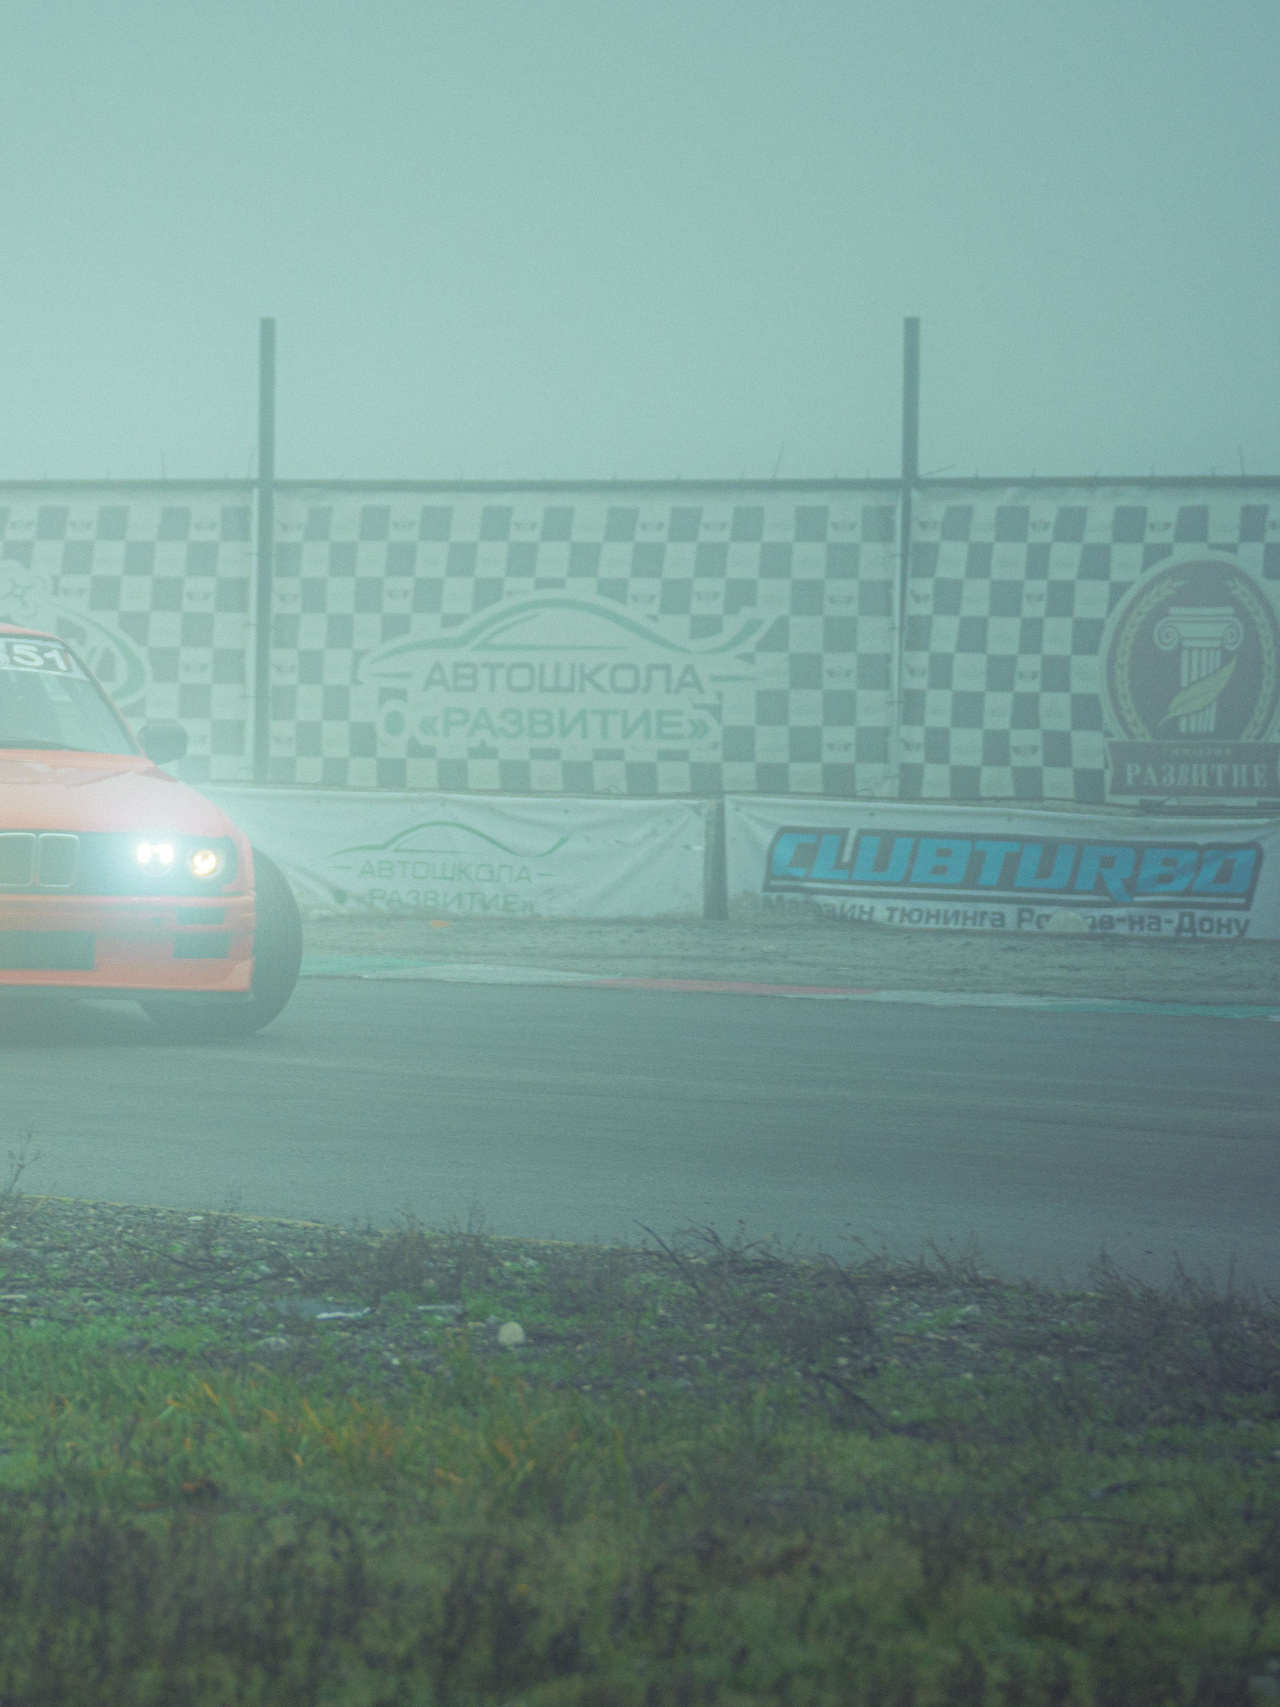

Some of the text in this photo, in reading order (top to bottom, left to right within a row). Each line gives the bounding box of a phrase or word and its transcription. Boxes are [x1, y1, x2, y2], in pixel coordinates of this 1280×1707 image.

[13, 643, 68, 672] 51
[422, 661, 704, 694] АВТОШКОЛА
[418, 706, 712, 741] «РАЗВИТИЕ»
[1125, 762, 1269, 788] РАЗВИТИЕ
[358, 859, 532, 882] АВТОШКОЛА
[771, 832, 1258, 900] CLUBTURBO
[886, 905, 1005, 928] тюнинга
